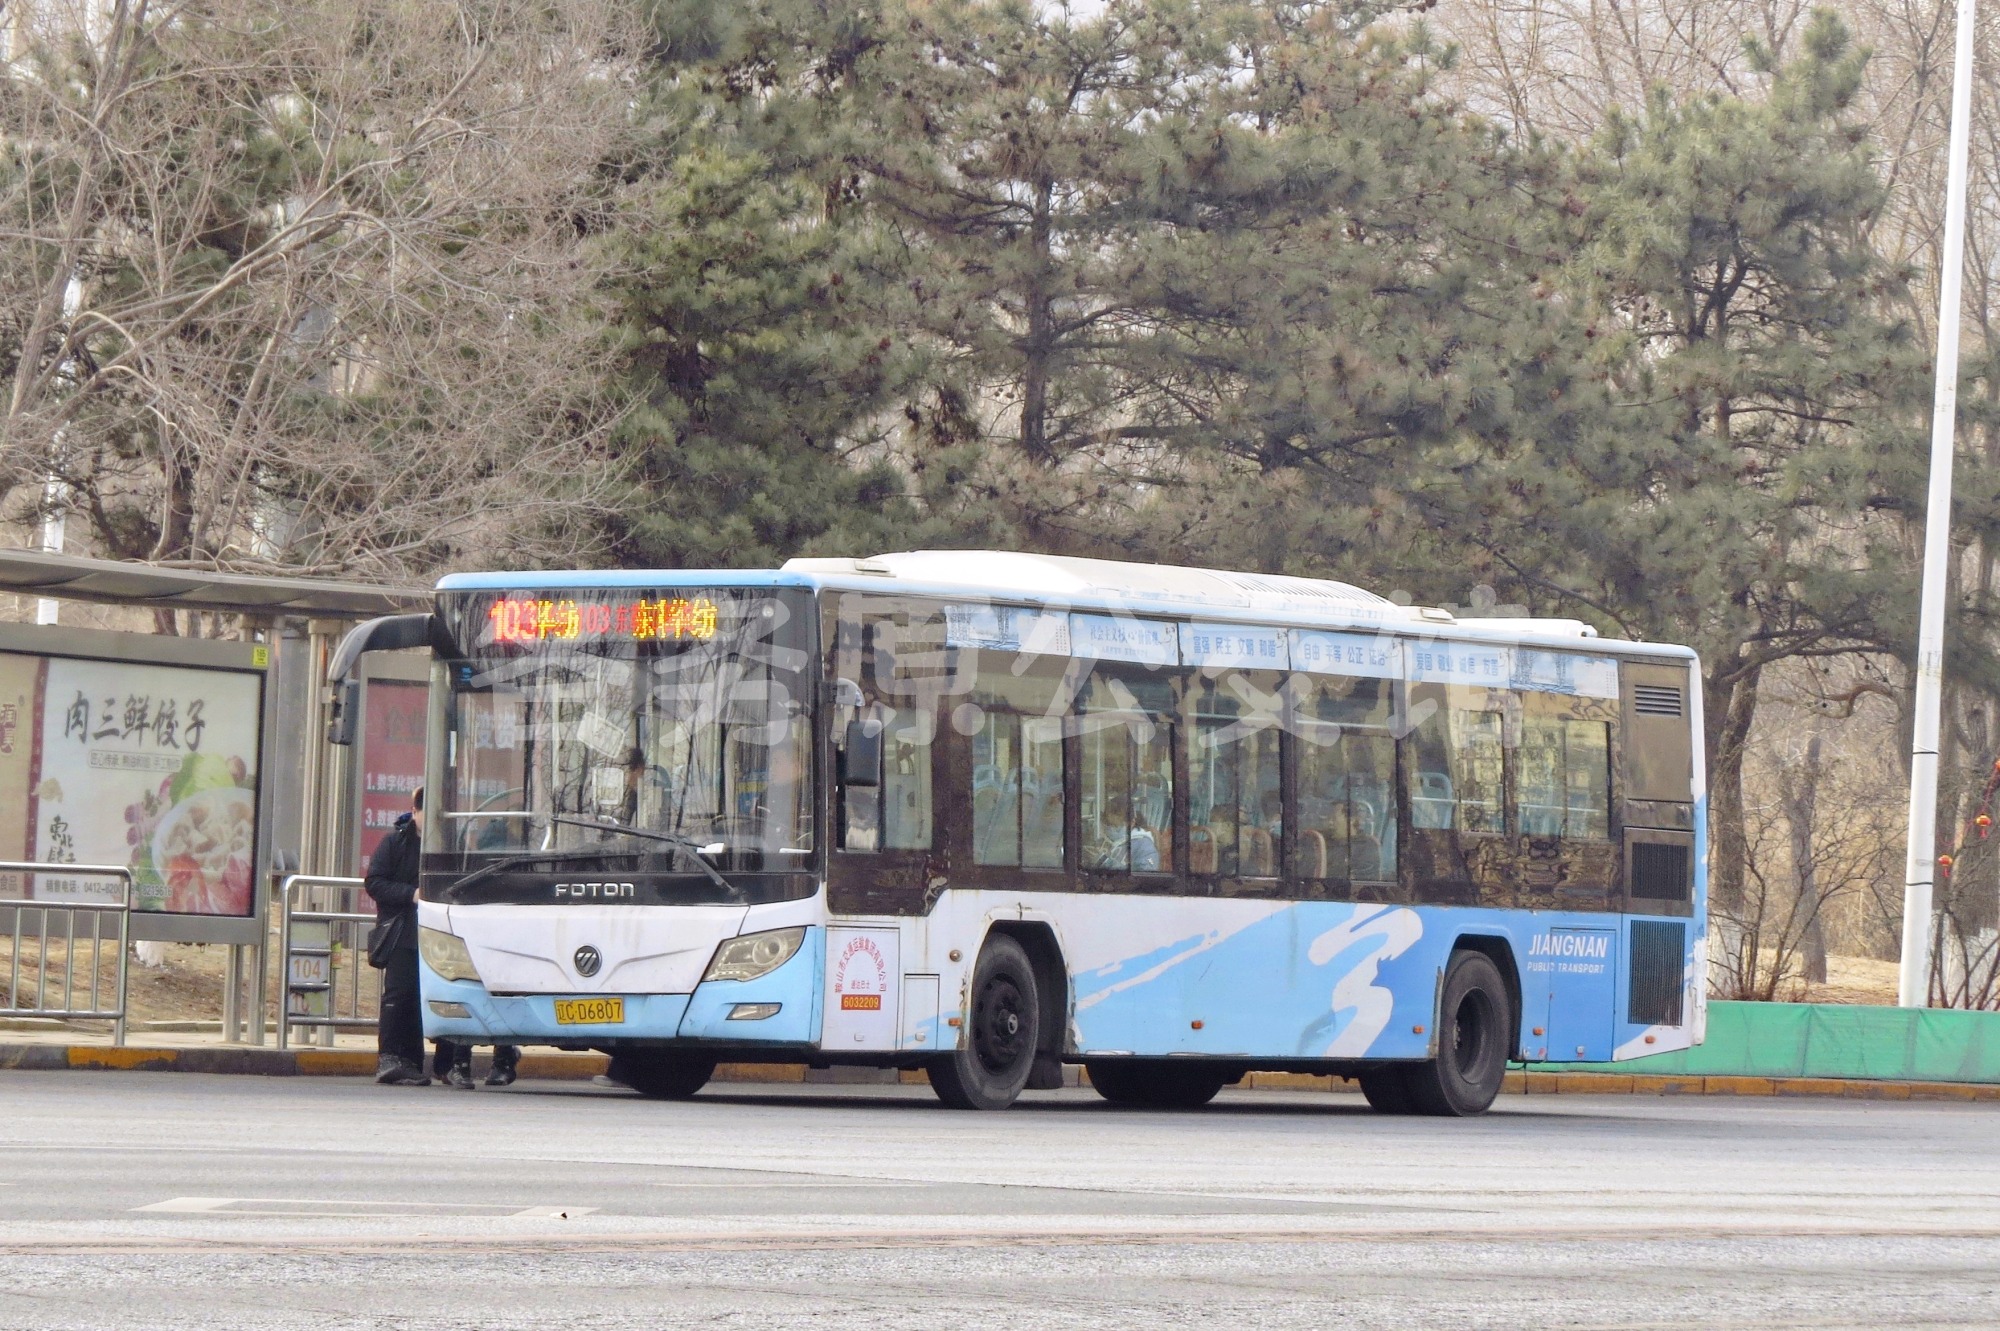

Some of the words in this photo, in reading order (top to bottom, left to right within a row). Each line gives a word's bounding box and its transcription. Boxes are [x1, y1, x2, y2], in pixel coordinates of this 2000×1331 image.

[1193, 636, 1210, 654] 富强
[1215, 636, 1232, 655] 民主
[1238, 637, 1255, 656] 文明
[1259, 639, 1276, 657] 和谐
[1304, 643, 1320, 660] 自由
[1325, 644, 1342, 663] 平等
[1347, 646, 1364, 665] 公正
[1416, 652, 1432, 670] 爱国
[64, 690, 206, 751] 肉三鲜饺子
[555, 883, 635, 897] FOTON
[1528, 934, 1608, 958] JIANGNAN
[294, 959, 321, 979] 104
[1527, 961, 1555, 972] PUBLIC
[1557, 963, 1605, 974] TRANSPORT
[843, 996, 880, 1009] 6032209
